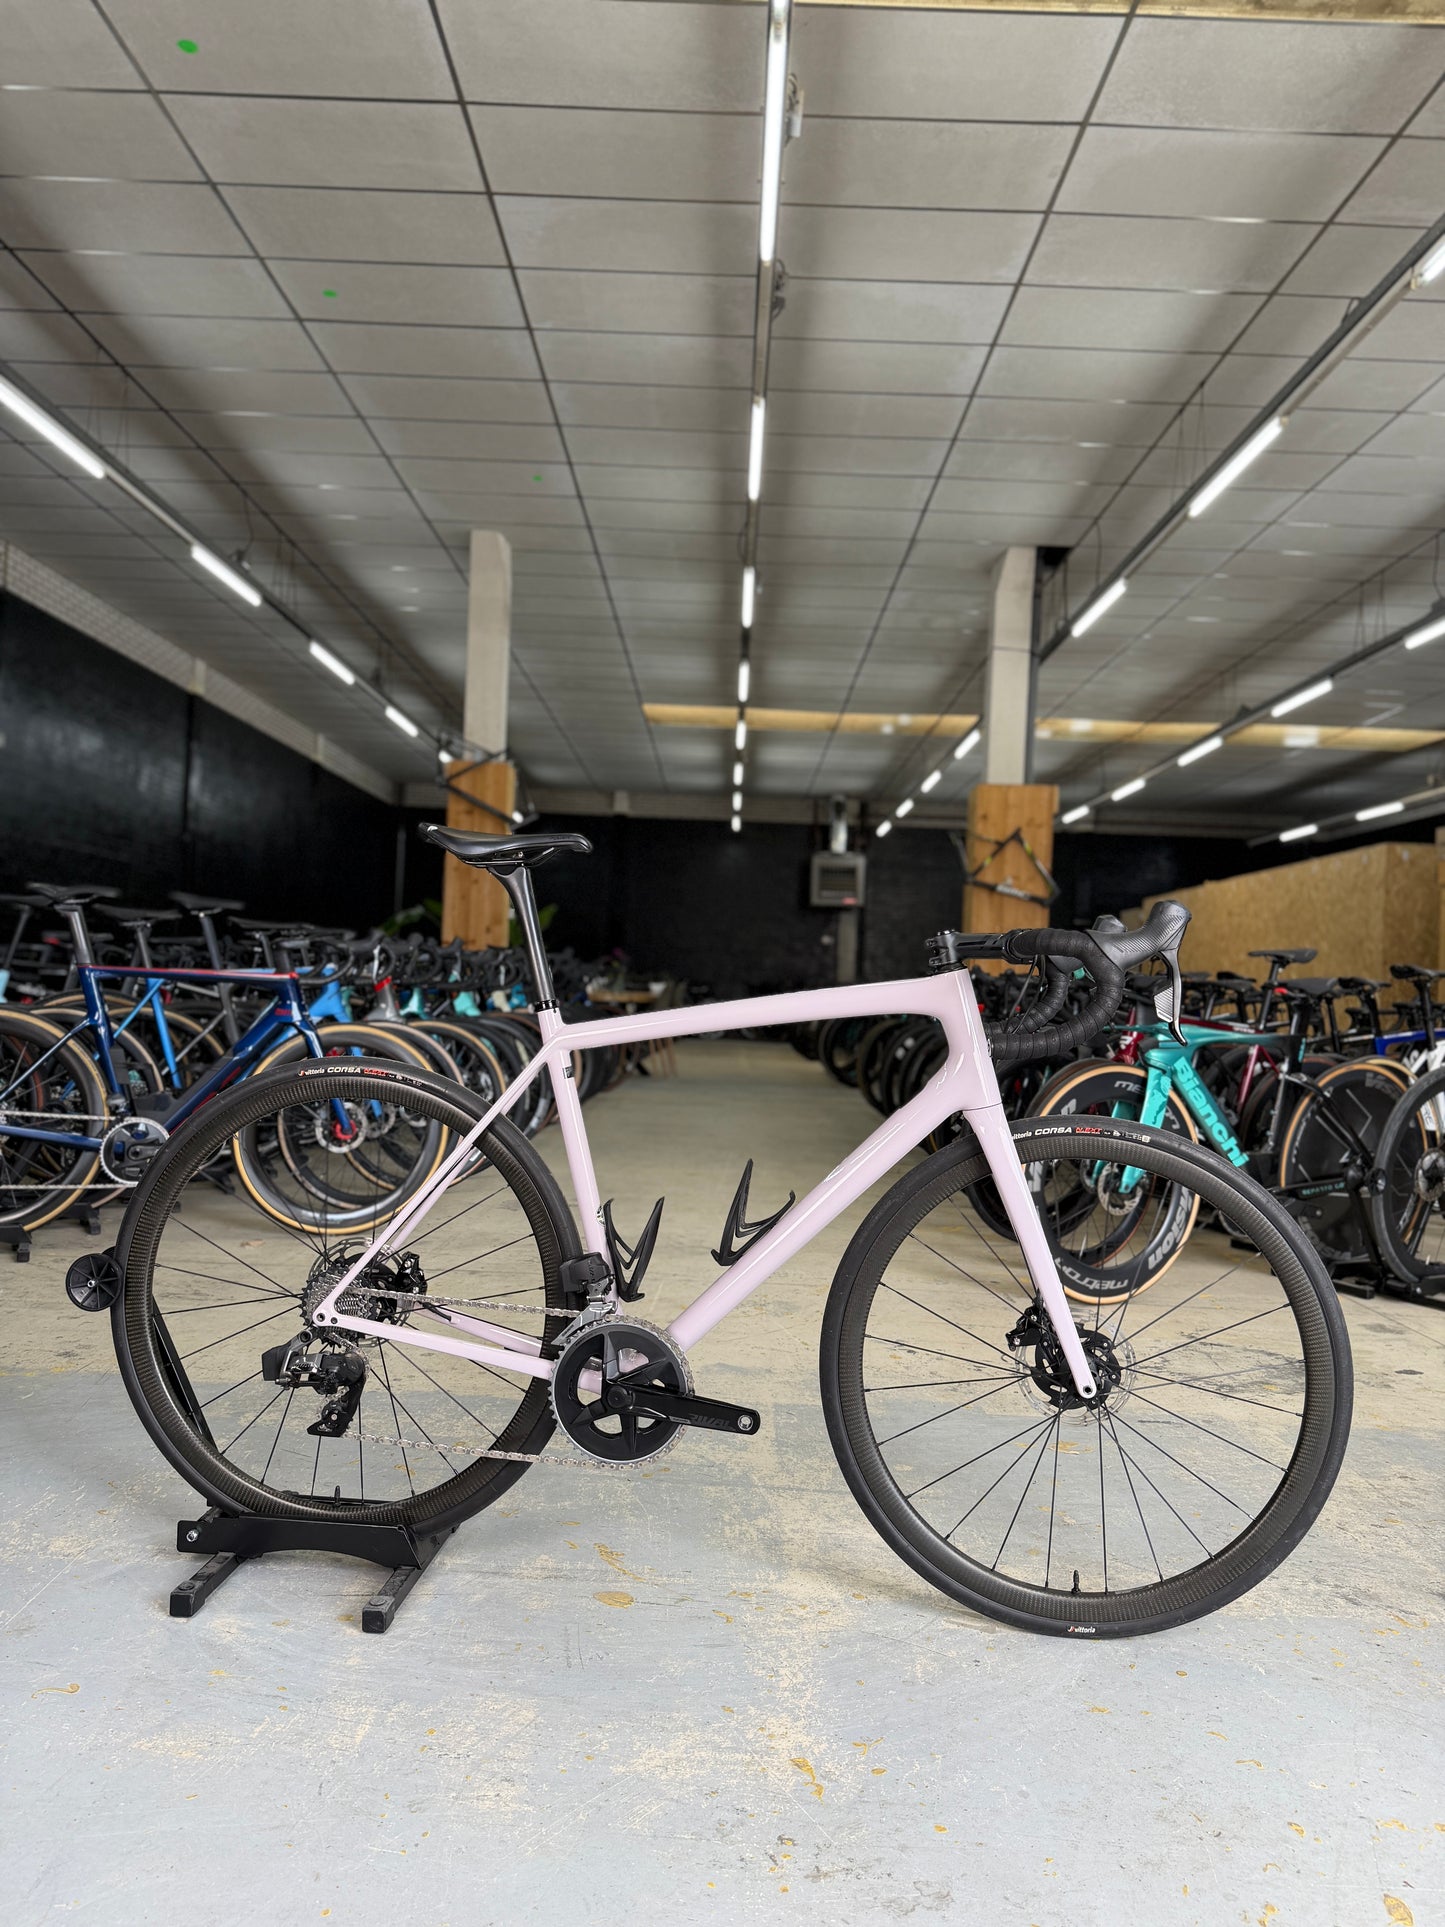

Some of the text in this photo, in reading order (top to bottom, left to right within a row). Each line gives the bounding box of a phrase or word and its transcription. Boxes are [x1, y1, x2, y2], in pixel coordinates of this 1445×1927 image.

[327, 1066, 361, 1074] CORSA
[1173, 1056, 1250, 1168] Bianchi
[1034, 1126, 1072, 1136] CORSA
[1074, 1625, 1096, 1633] vittoria
